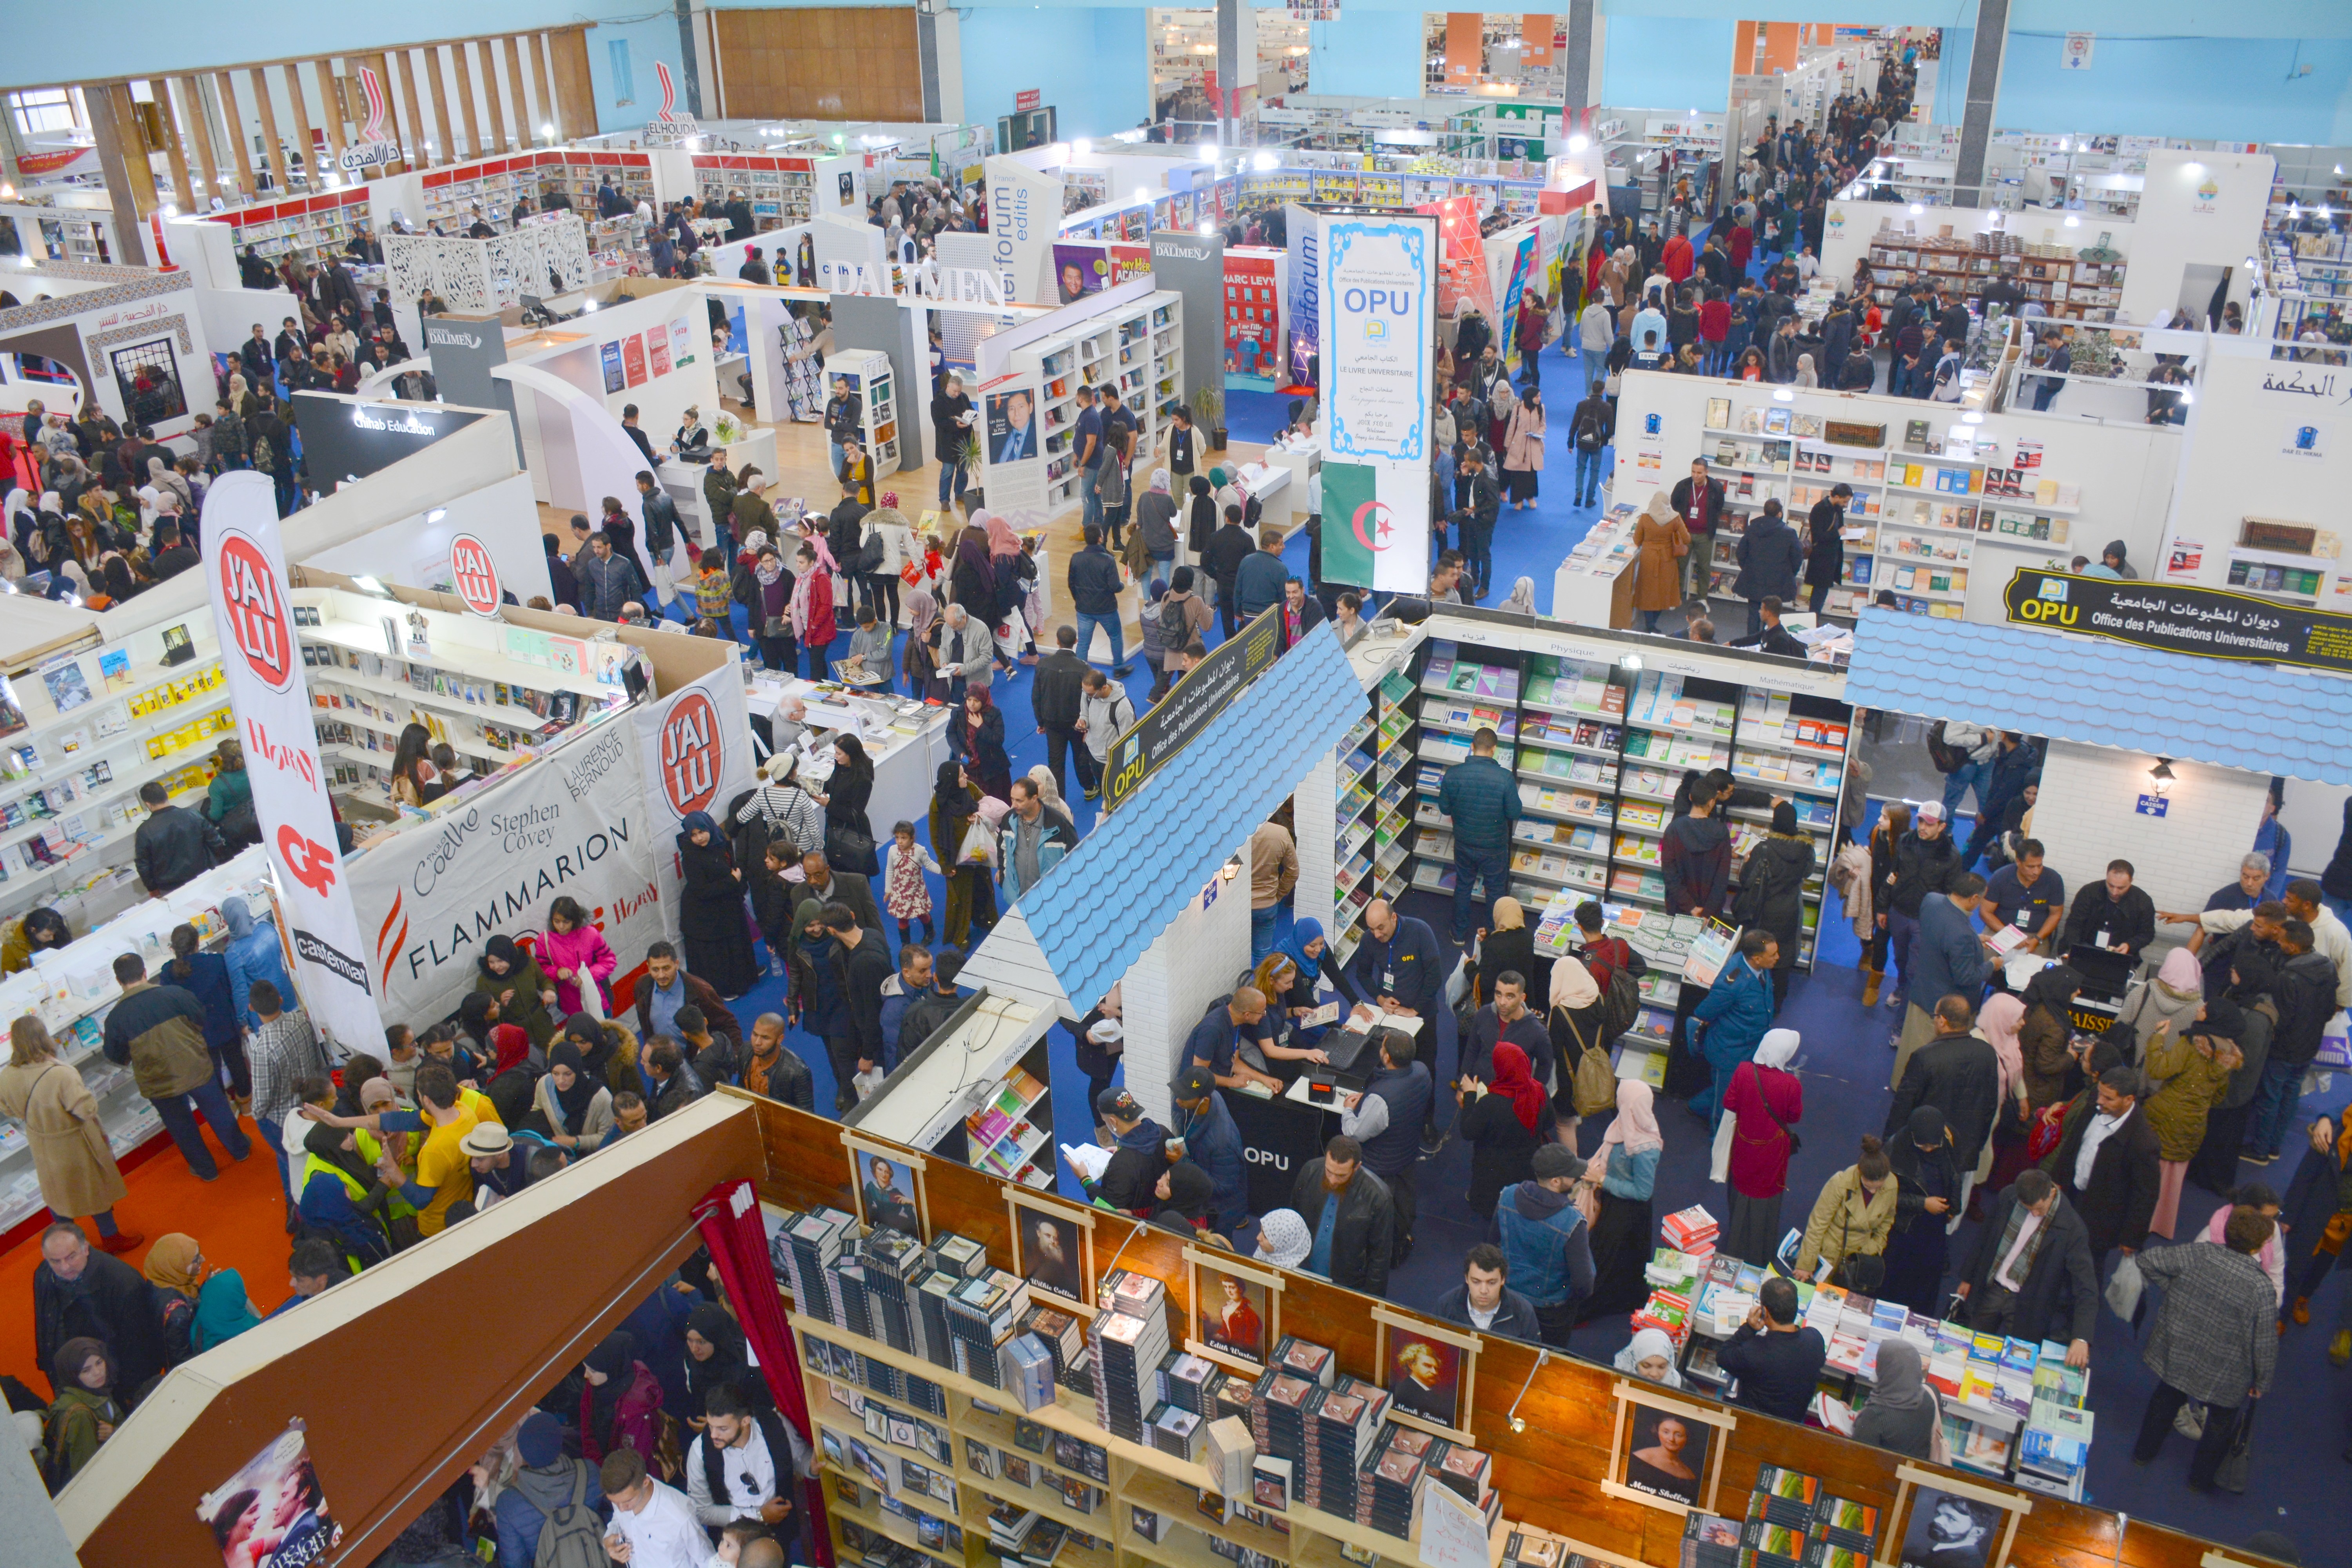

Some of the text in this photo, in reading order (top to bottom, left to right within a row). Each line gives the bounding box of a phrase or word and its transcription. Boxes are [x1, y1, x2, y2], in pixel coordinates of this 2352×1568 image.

[675, 114, 693, 123] DAR
[343, 142, 399, 168] دار الهدى
[1014, 188, 1028, 241] editis
[1122, 257, 1151, 272] MY HER
[1156, 247, 1201, 259] DALIMEN
[828, 260, 1007, 307] DALIMEN
[1223, 275, 1276, 287] MARC LEVY
[122, 304, 156, 323] القصبة
[158, 302, 168, 318] دار
[1344, 288, 1409, 316] OPU
[429, 333, 473, 346] DALIMEN
[1355, 355, 1398, 364] الكتاب الجامعي
[1367, 368, 1414, 377] UNIVERSITAIRE
[979, 376, 1004, 391] NOUVEAUTÉ
[2263, 370, 2336, 398] الحكمة
[387, 420, 436, 436] Education
[1355, 433, 1367, 442] Soyez
[455, 547, 489, 577] J'AI
[226, 550, 276, 622] J'AI
[463, 575, 494, 604] LU
[2020, 599, 2079, 625] OPU
[2110, 592, 2280, 631] ديوان المطبوعات الجامعية
[236, 605, 282, 675] LU
[1405, 638, 1418, 653] Chimie
[1462, 633, 1486, 642] فيزياء
[2092, 612, 2290, 653] Office des Publications Universitaires
[1550, 643, 1595, 657] Physique
[1219, 655, 1236, 678] ديوان
[1667, 663, 1700, 673] رياضيات
[1188, 668, 1218, 704] المطبوعات
[1759, 676, 1815, 691] Mathématique
[1152, 672, 1240, 760] Office des Publications Universitaires
[1160, 695, 1187, 730] الجامعية
[666, 704, 711, 767] J'AI
[247, 716, 319, 795] HORAY
[564, 726, 620, 789] LAURENCE
[570, 741, 624, 803] PERNOUD
[675, 749, 714, 808] LU
[1114, 752, 1145, 797] OPU
[2140, 800, 2165, 810] CAISSE
[490, 802, 561, 837] Stephen
[414, 804, 480, 898] Coelho
[426, 837, 446, 862] PAULO
[503, 826, 555, 854] Covey
[408, 817, 629, 980] FLAMMARION
[612, 882, 659, 925] HORAY
[1004, 1034, 1033, 1066] Biologie
[926, 1122, 948, 1145] بيولوجيا
[1244, 1147, 1289, 1171] OPU
[1030, 1278, 1077, 1300] Wilkie Collins
[1209, 1339, 1259, 1362] Edith Warton
[1394, 1402, 1448, 1426] Mark Twain
[1630, 1480, 1691, 1505] Mary Shelley
[282, 1526, 328, 1568] before
